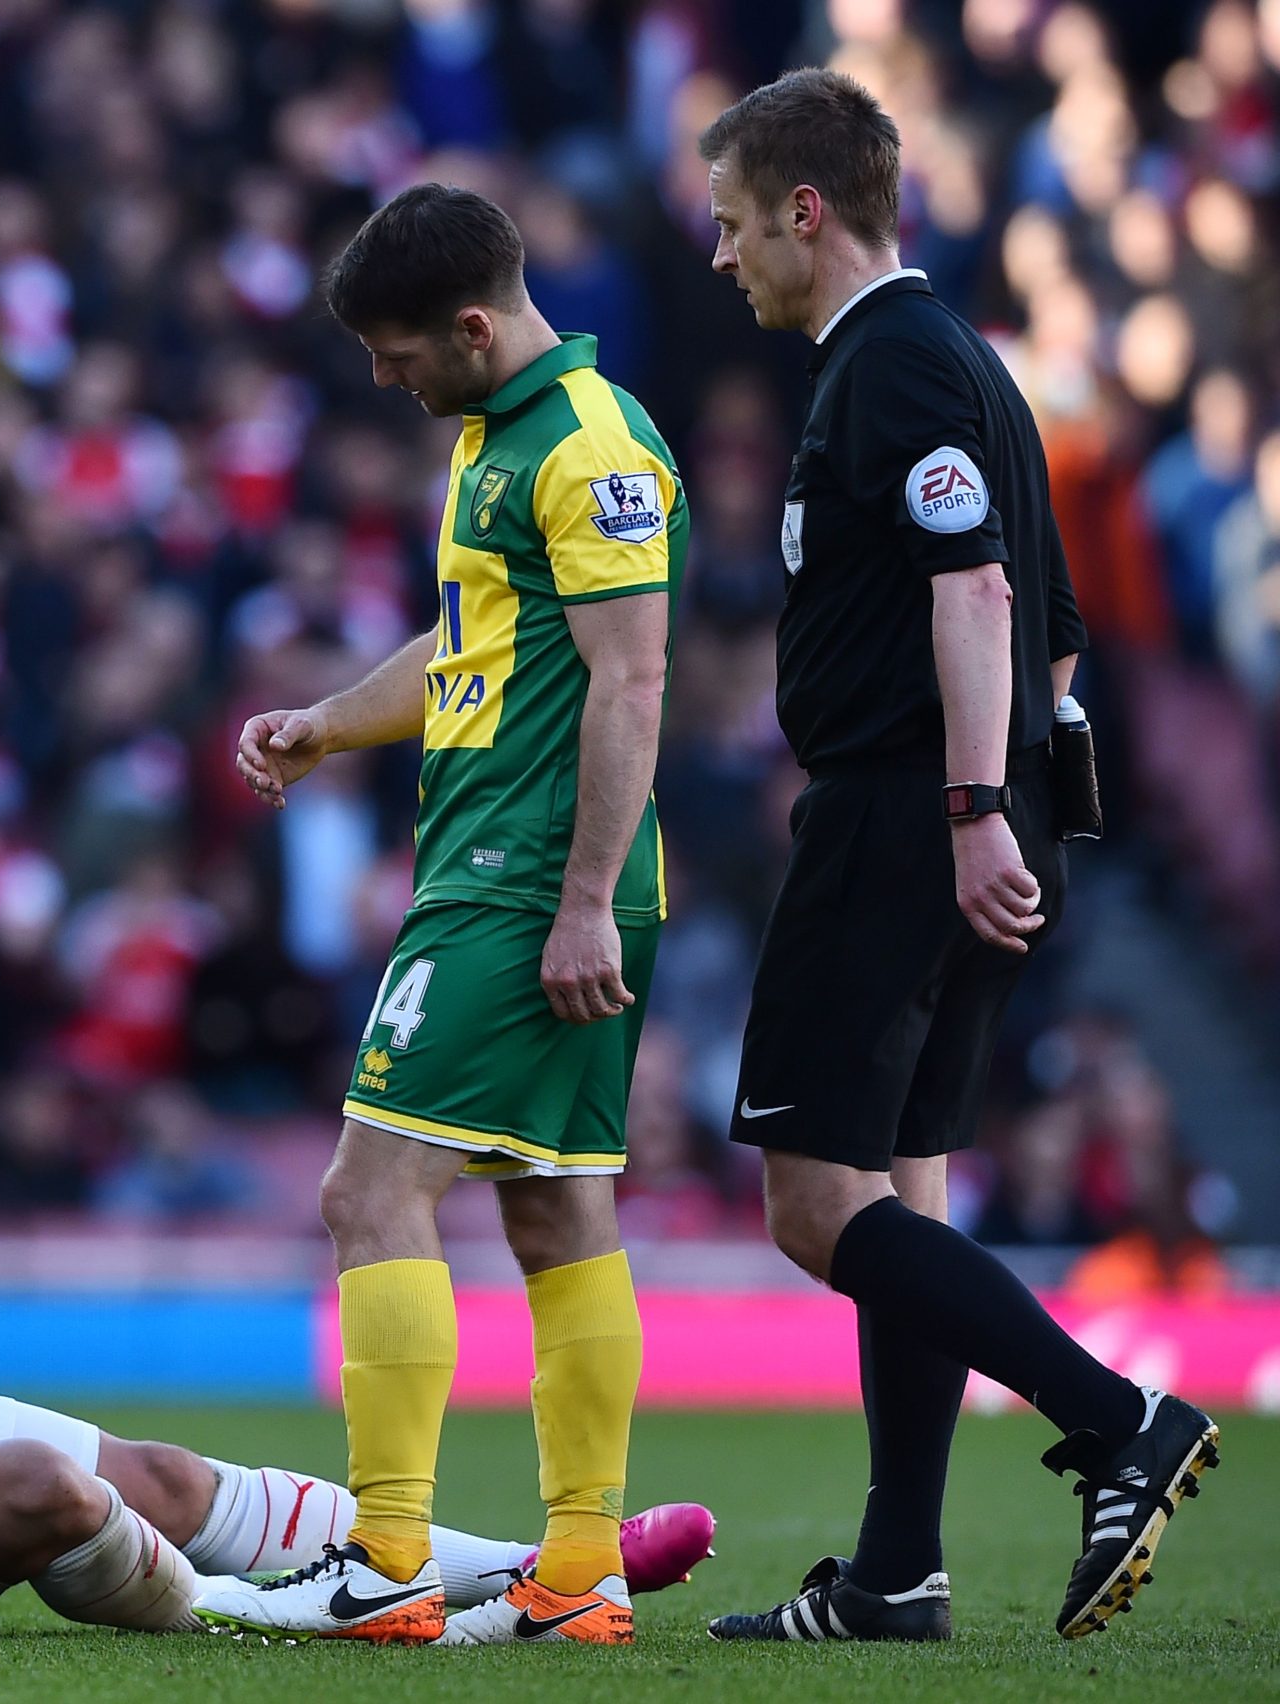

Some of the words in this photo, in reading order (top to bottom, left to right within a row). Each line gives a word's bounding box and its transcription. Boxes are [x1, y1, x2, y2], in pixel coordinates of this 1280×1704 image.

[920, 464, 977, 504] EA
[922, 492, 981, 517] SPORTS
[607, 513, 650, 528] BARCLAYS
